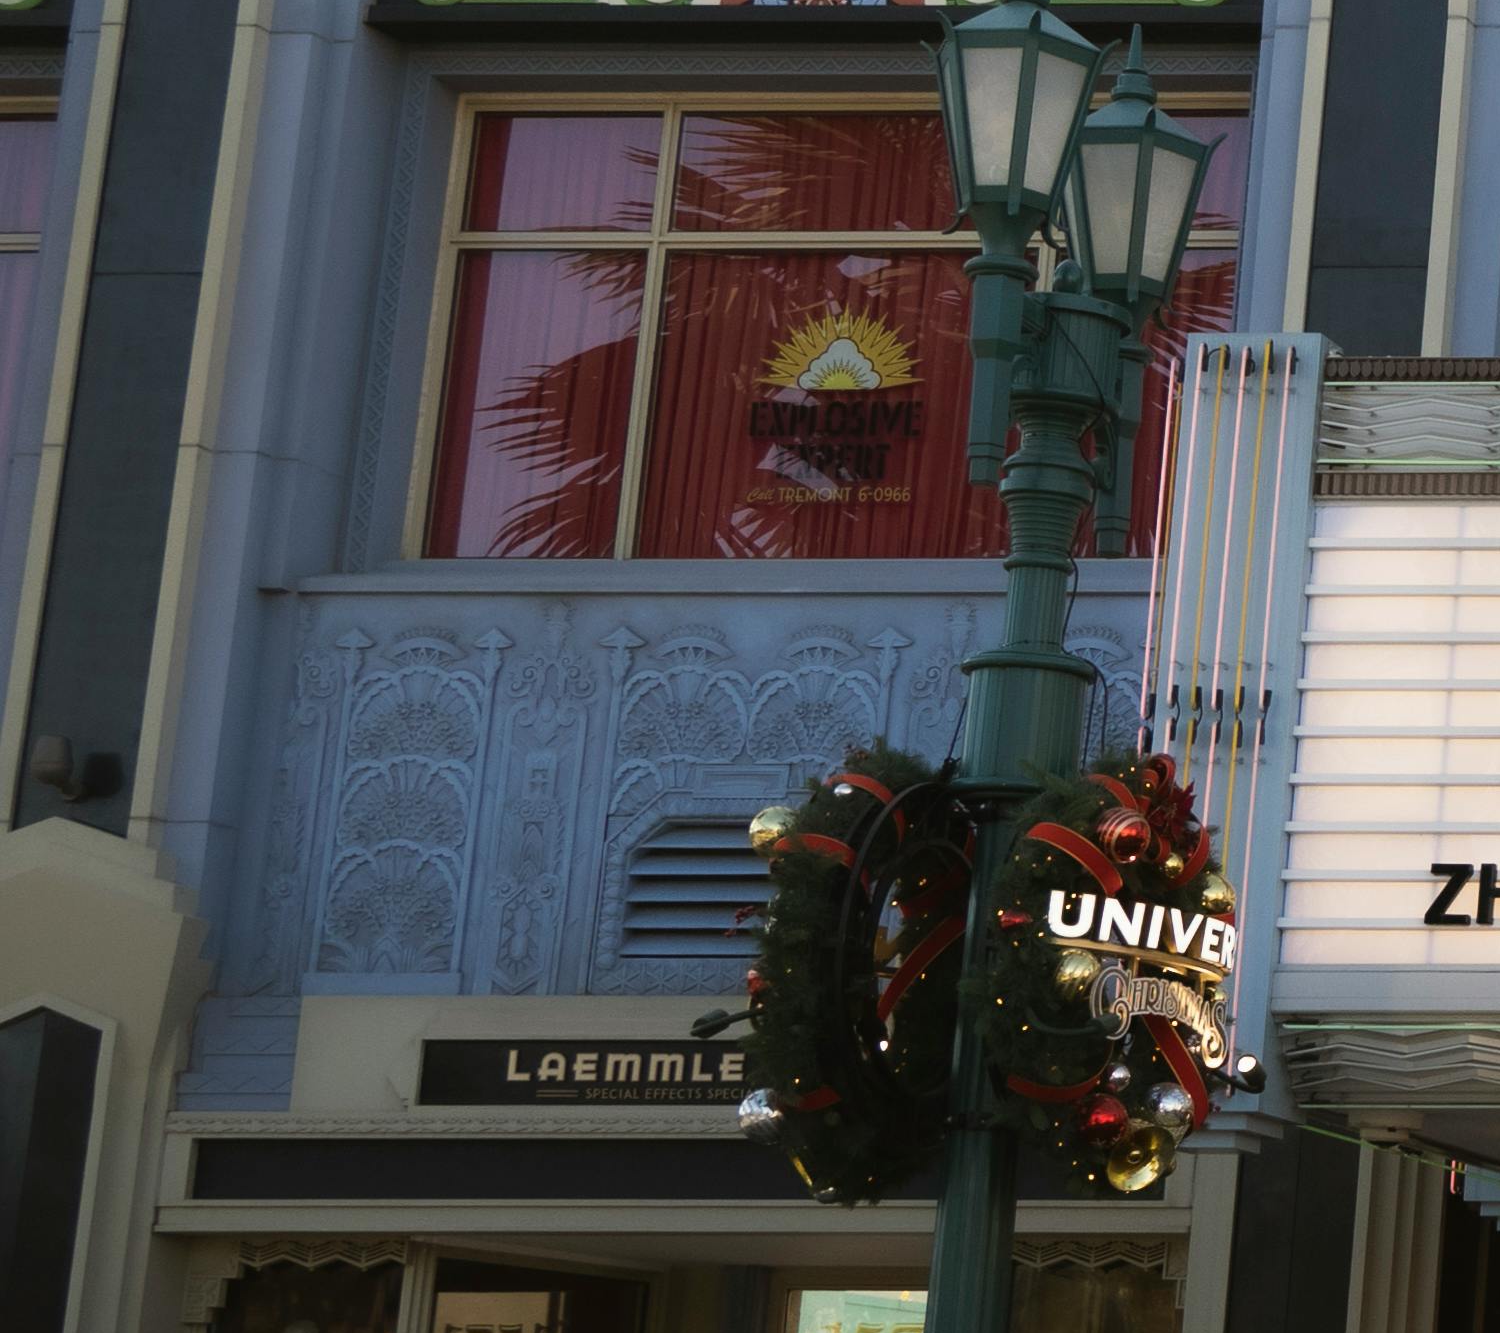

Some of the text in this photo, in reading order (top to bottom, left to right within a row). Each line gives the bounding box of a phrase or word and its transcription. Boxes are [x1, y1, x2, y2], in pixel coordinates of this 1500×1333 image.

[749, 400, 924, 438] EXPLOSIVE
[778, 486, 852, 503] TREMONT
[858, 486, 911, 503] 6-0966
[1048, 889, 1241, 970] UNIVER
[506, 1049, 745, 1082] LAEMMLE
[585, 1088, 640, 1100] SPECIAL
[644, 1088, 703, 1100] EFFECTS
